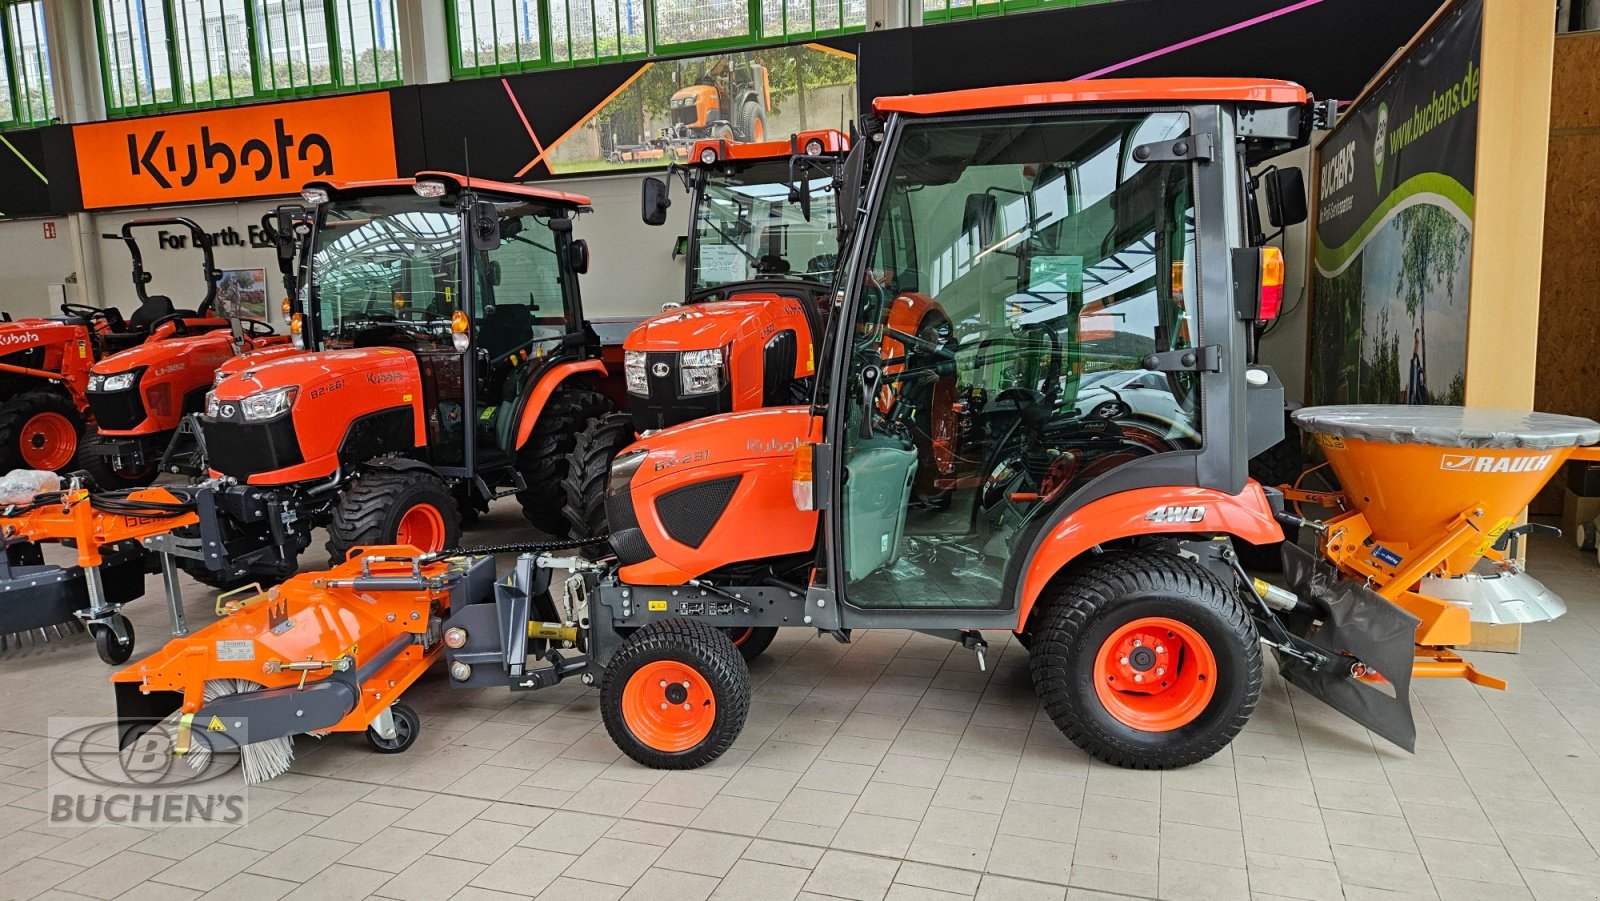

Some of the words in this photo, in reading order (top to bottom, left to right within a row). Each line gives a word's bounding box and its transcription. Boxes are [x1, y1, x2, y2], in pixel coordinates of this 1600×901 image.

[1390, 61, 1479, 156] www.buchens.de
[127, 118, 334, 189] Kubota
[1320, 140, 1356, 201] BUCHEN'S
[158, 230, 187, 250] For
[366, 370, 404, 384] Kubota
[310, 380, 345, 399] B2-261
[746, 436, 810, 453] Kubot
[1474, 455, 1553, 473] RAUCH
[1144, 506, 1206, 523] 4WD
